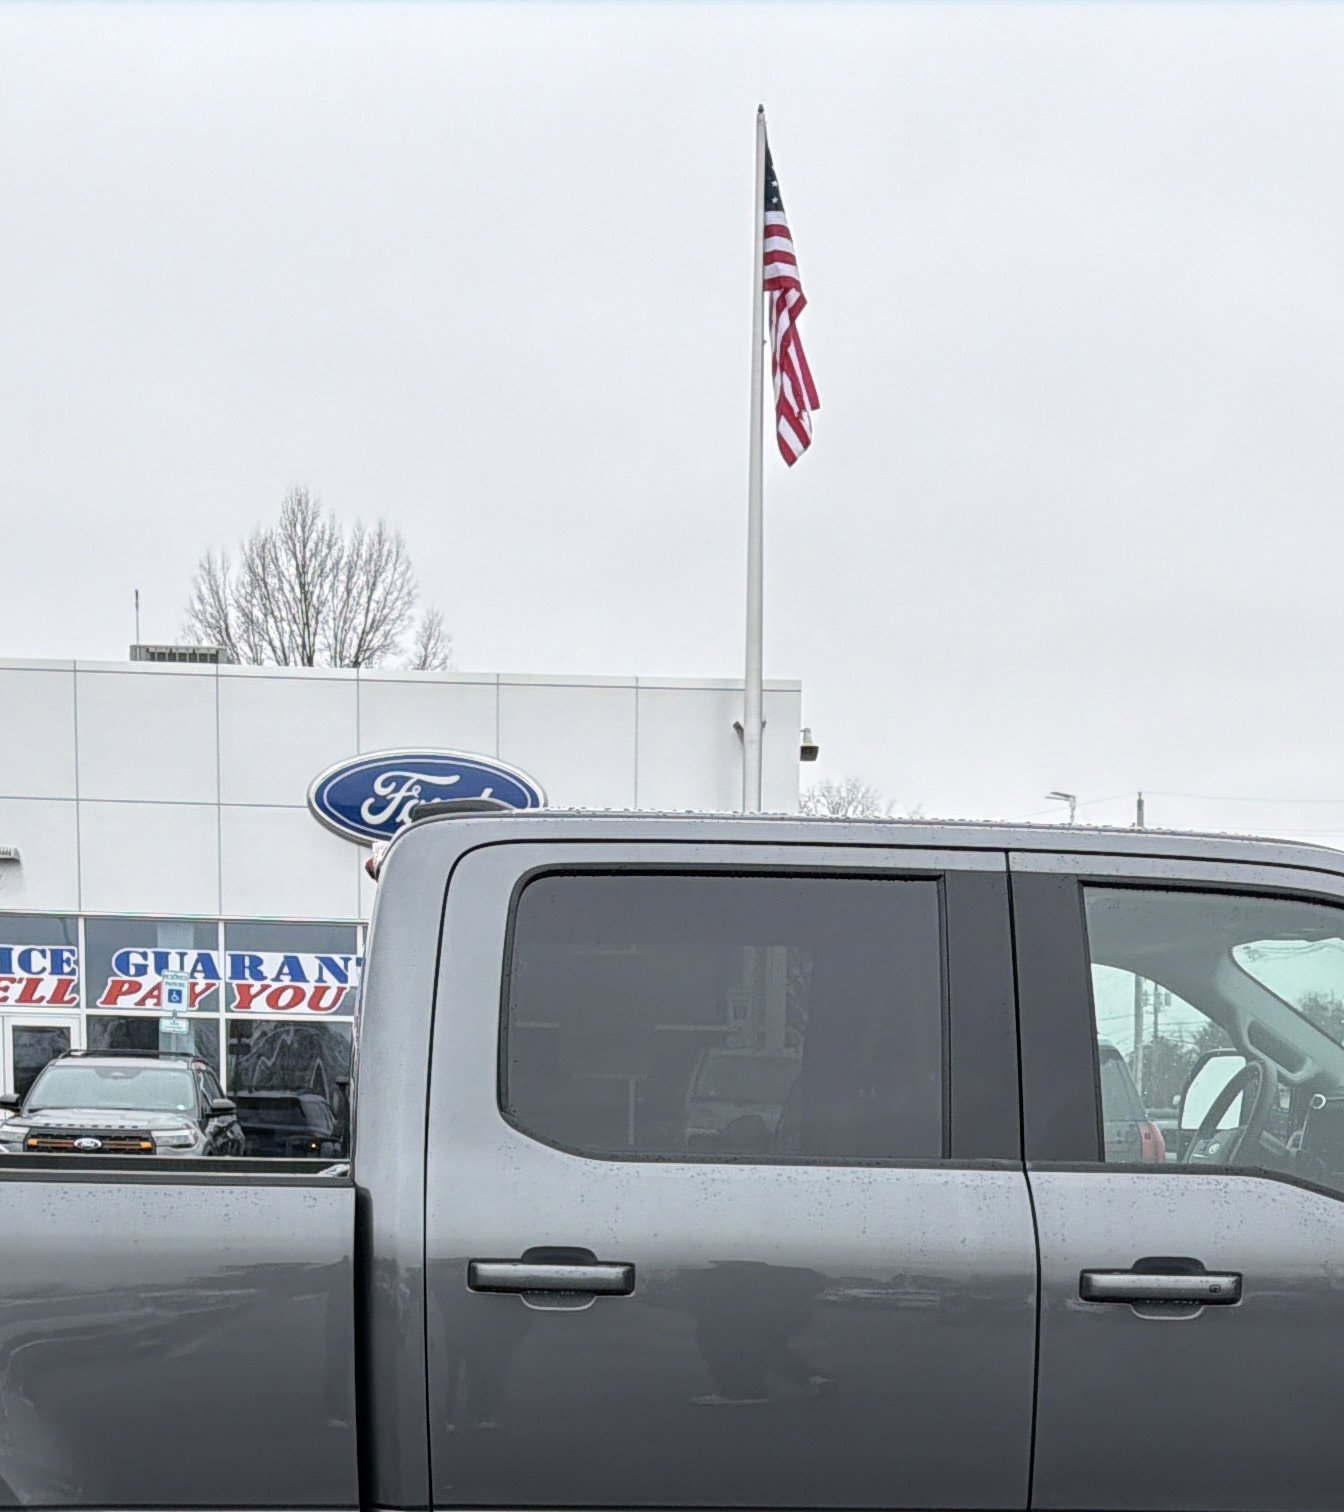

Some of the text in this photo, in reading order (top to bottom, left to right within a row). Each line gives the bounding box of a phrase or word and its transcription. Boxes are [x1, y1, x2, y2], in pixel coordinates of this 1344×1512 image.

[113, 950, 364, 984] GUARAN
[98, 979, 218, 1008] PAY
[232, 983, 348, 1012] YOU
